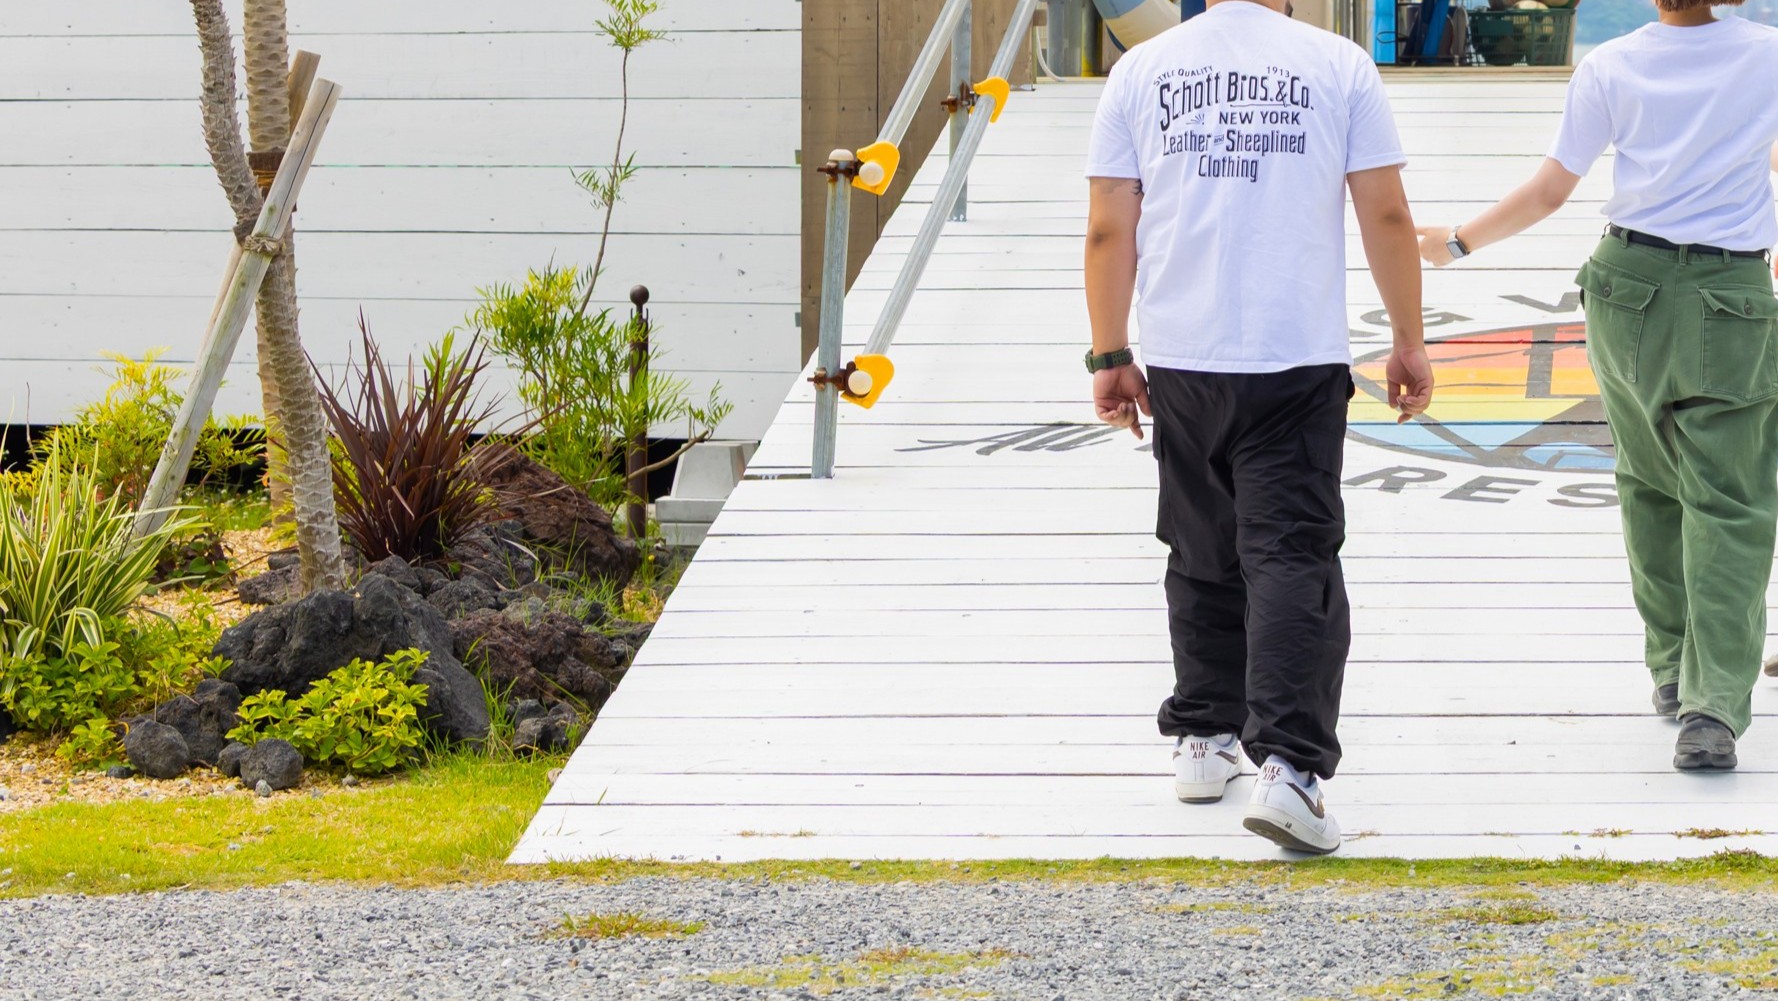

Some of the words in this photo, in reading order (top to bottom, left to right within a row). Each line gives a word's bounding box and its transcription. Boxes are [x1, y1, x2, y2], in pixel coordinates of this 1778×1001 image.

[1177, 65, 1213, 77] QUALITY
[1266, 66, 1291, 78] 1913
[1159, 72, 1221, 132] Schott
[1218, 111, 1254, 125] NEW
[1261, 111, 1301, 126] YORK
[1163, 130, 1211, 157] Leather
[1226, 129, 1306, 157] Sheeplined
[1198, 155, 1259, 183] Clothing
[1190, 741, 1209, 751] NIKE
[1192, 751, 1206, 759] AIR
[1263, 764, 1283, 776] NIKE
[1263, 773, 1276, 782] AIR
